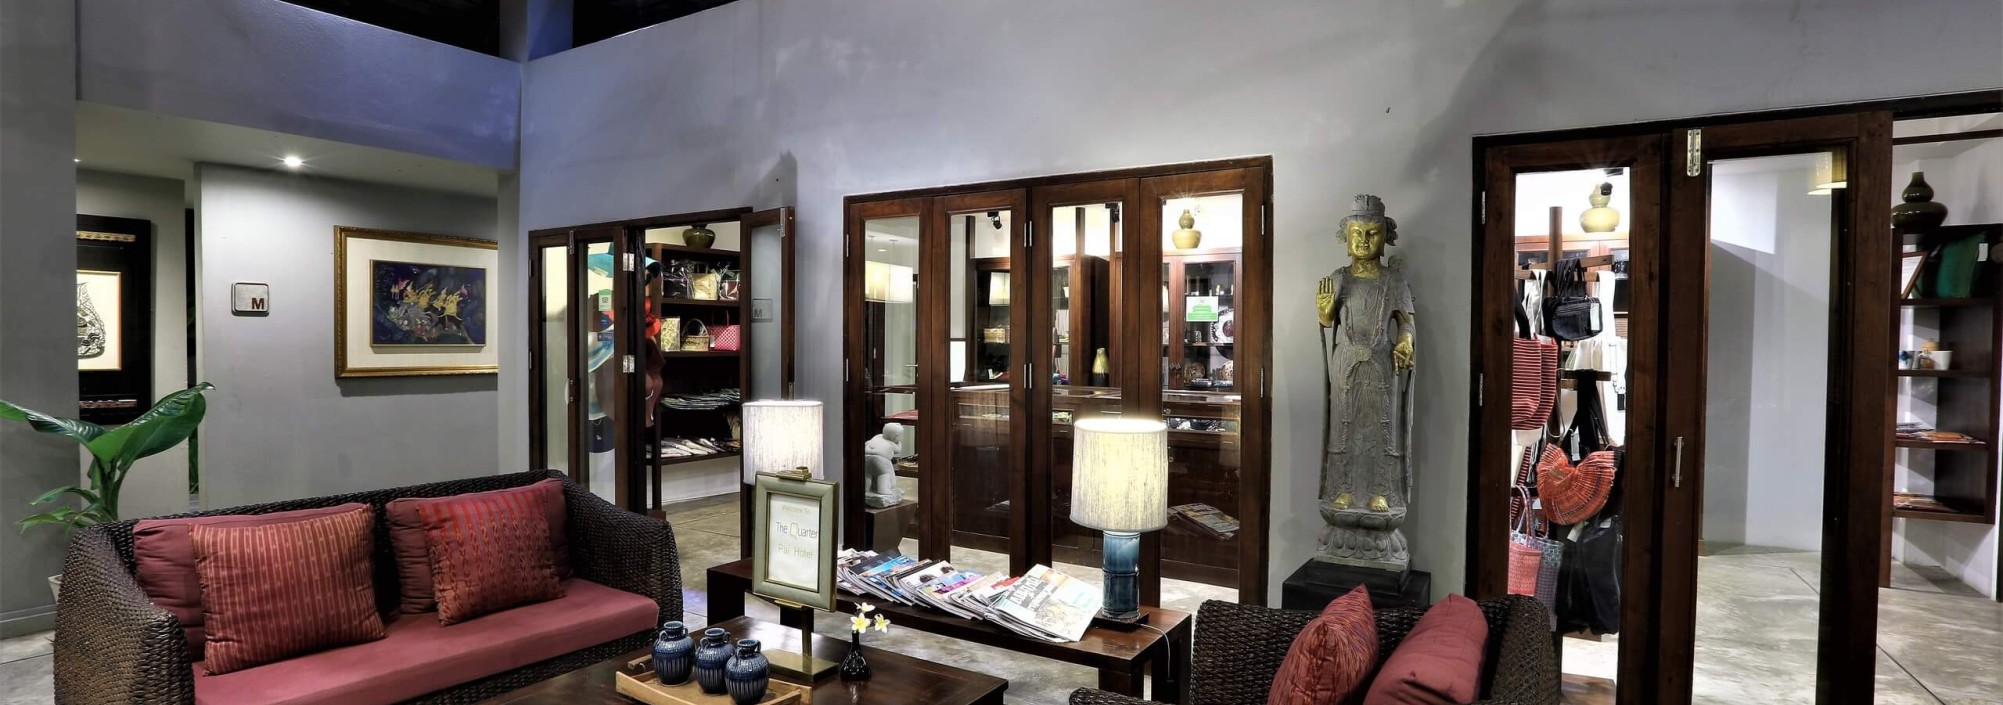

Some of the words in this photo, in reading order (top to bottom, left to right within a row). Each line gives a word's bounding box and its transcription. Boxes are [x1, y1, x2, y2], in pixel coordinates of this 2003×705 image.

[252, 297, 265, 310] M
[782, 504, 803, 514] Welcome
[776, 521, 788, 534] The
[790, 523, 818, 540] Quarter
[794, 547, 813, 558] Hotel
